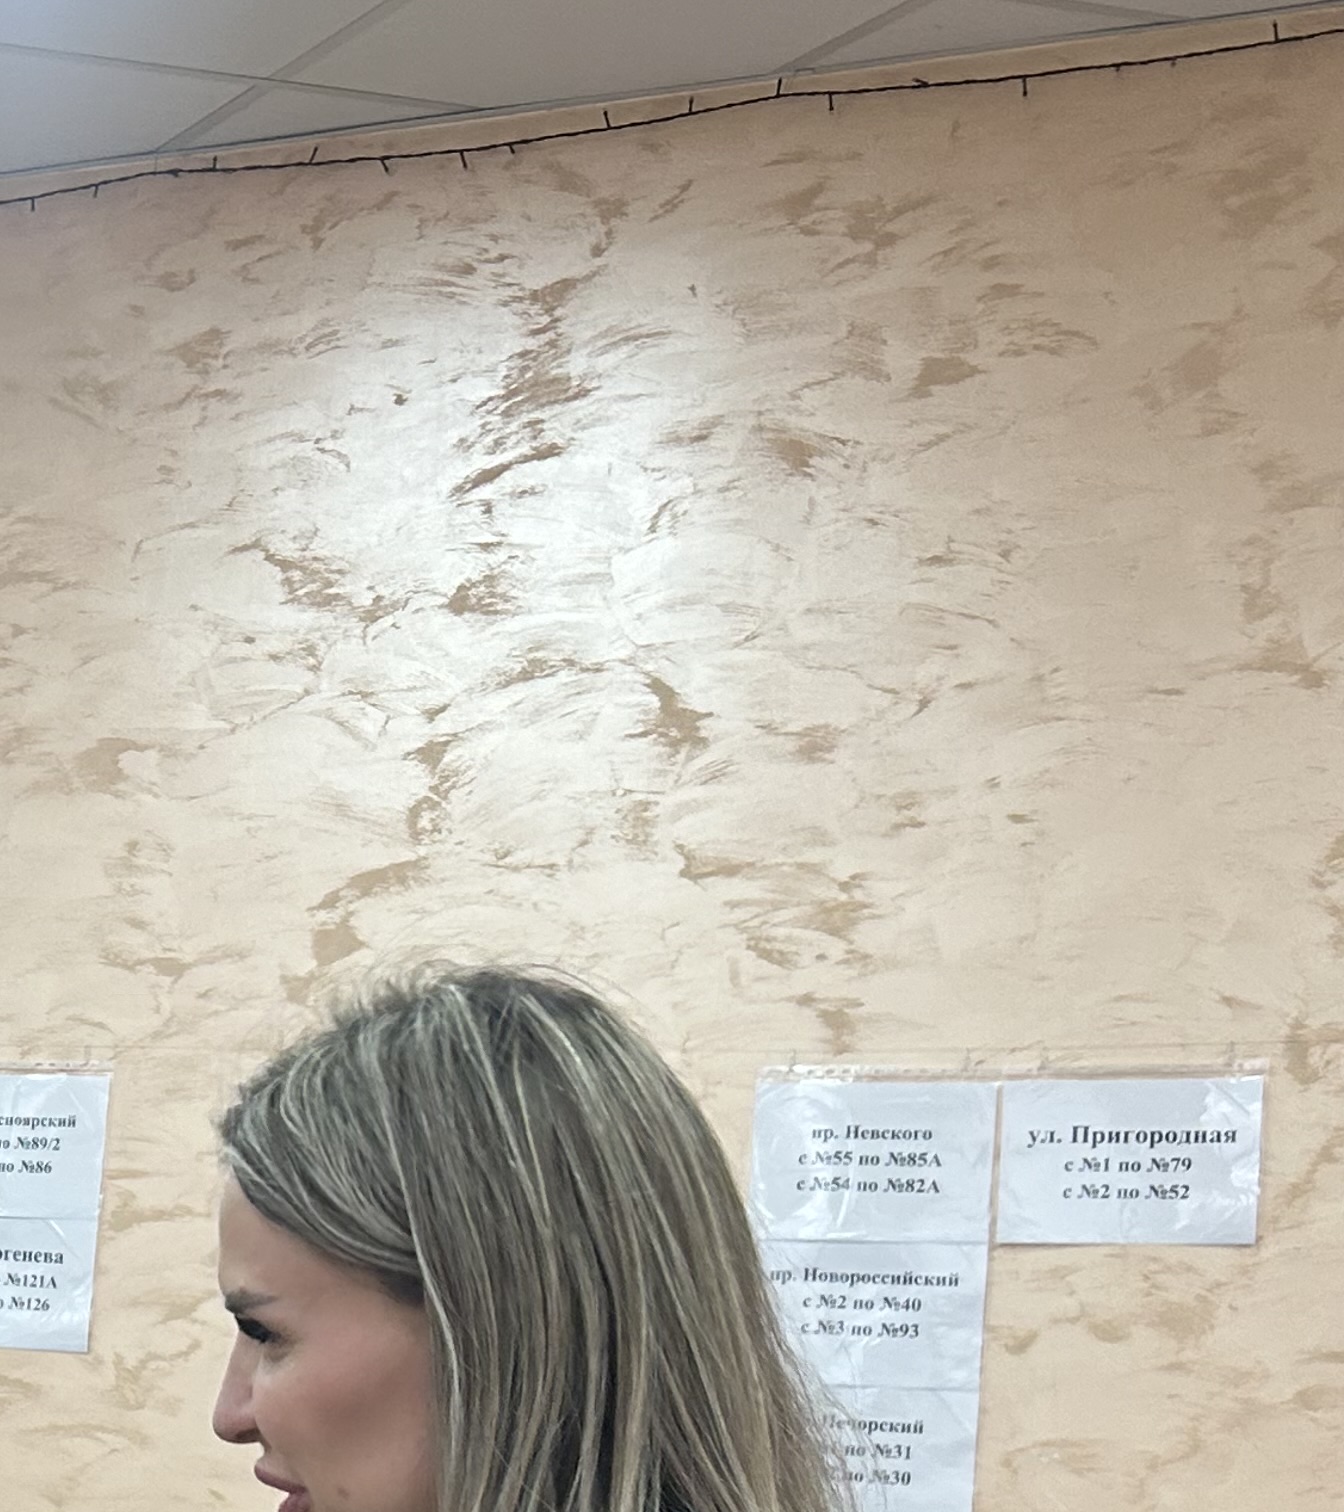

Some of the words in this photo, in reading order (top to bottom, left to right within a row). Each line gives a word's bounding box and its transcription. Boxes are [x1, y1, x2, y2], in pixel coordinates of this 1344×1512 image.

[812, 1128, 838, 1143] пр.
[845, 1125, 932, 1140] Невского
[1027, 1129, 1062, 1148] ул.
[1072, 1125, 1237, 1148] Пригородная
[14, 1136, 60, 1151] №89/2
[18, 1160, 52, 1173] №86
[799, 1153, 807, 1165] с
[812, 1151, 853, 1166] №55
[858, 1154, 880, 1166] по
[885, 1152, 942, 1167] №85А
[1065, 1160, 1074, 1172] с
[1079, 1157, 1110, 1172] №1
[1119, 1160, 1141, 1173] по
[1146, 1157, 1192, 1173] №79
[796, 1179, 805, 1191] с
[810, 1177, 850, 1192] №54
[857, 1180, 878, 1192] по
[883, 1178, 940, 1193] №82А
[1063, 1187, 1072, 1199] с
[1077, 1184, 1110, 1199] №2
[1117, 1187, 1139, 1199] по
[1145, 1184, 1190, 1199] №52
[3, 1273, 57, 1289] №121А
[771, 1269, 796, 1285] пр.
[804, 1268, 959, 1287] Новороссийский
[8, 1296, 50, 1311] №126
[803, 1296, 811, 1308] с
[816, 1294, 846, 1309] №2
[853, 1299, 874, 1311] по
[879, 1296, 921, 1313] №40
[801, 1322, 809, 1334] с
[814, 1320, 844, 1335] №3
[851, 1324, 872, 1336] по
[878, 1322, 920, 1338] №93
[845, 1445, 866, 1456] по
[871, 1443, 911, 1460] №31
[868, 1469, 911, 1486] №30
